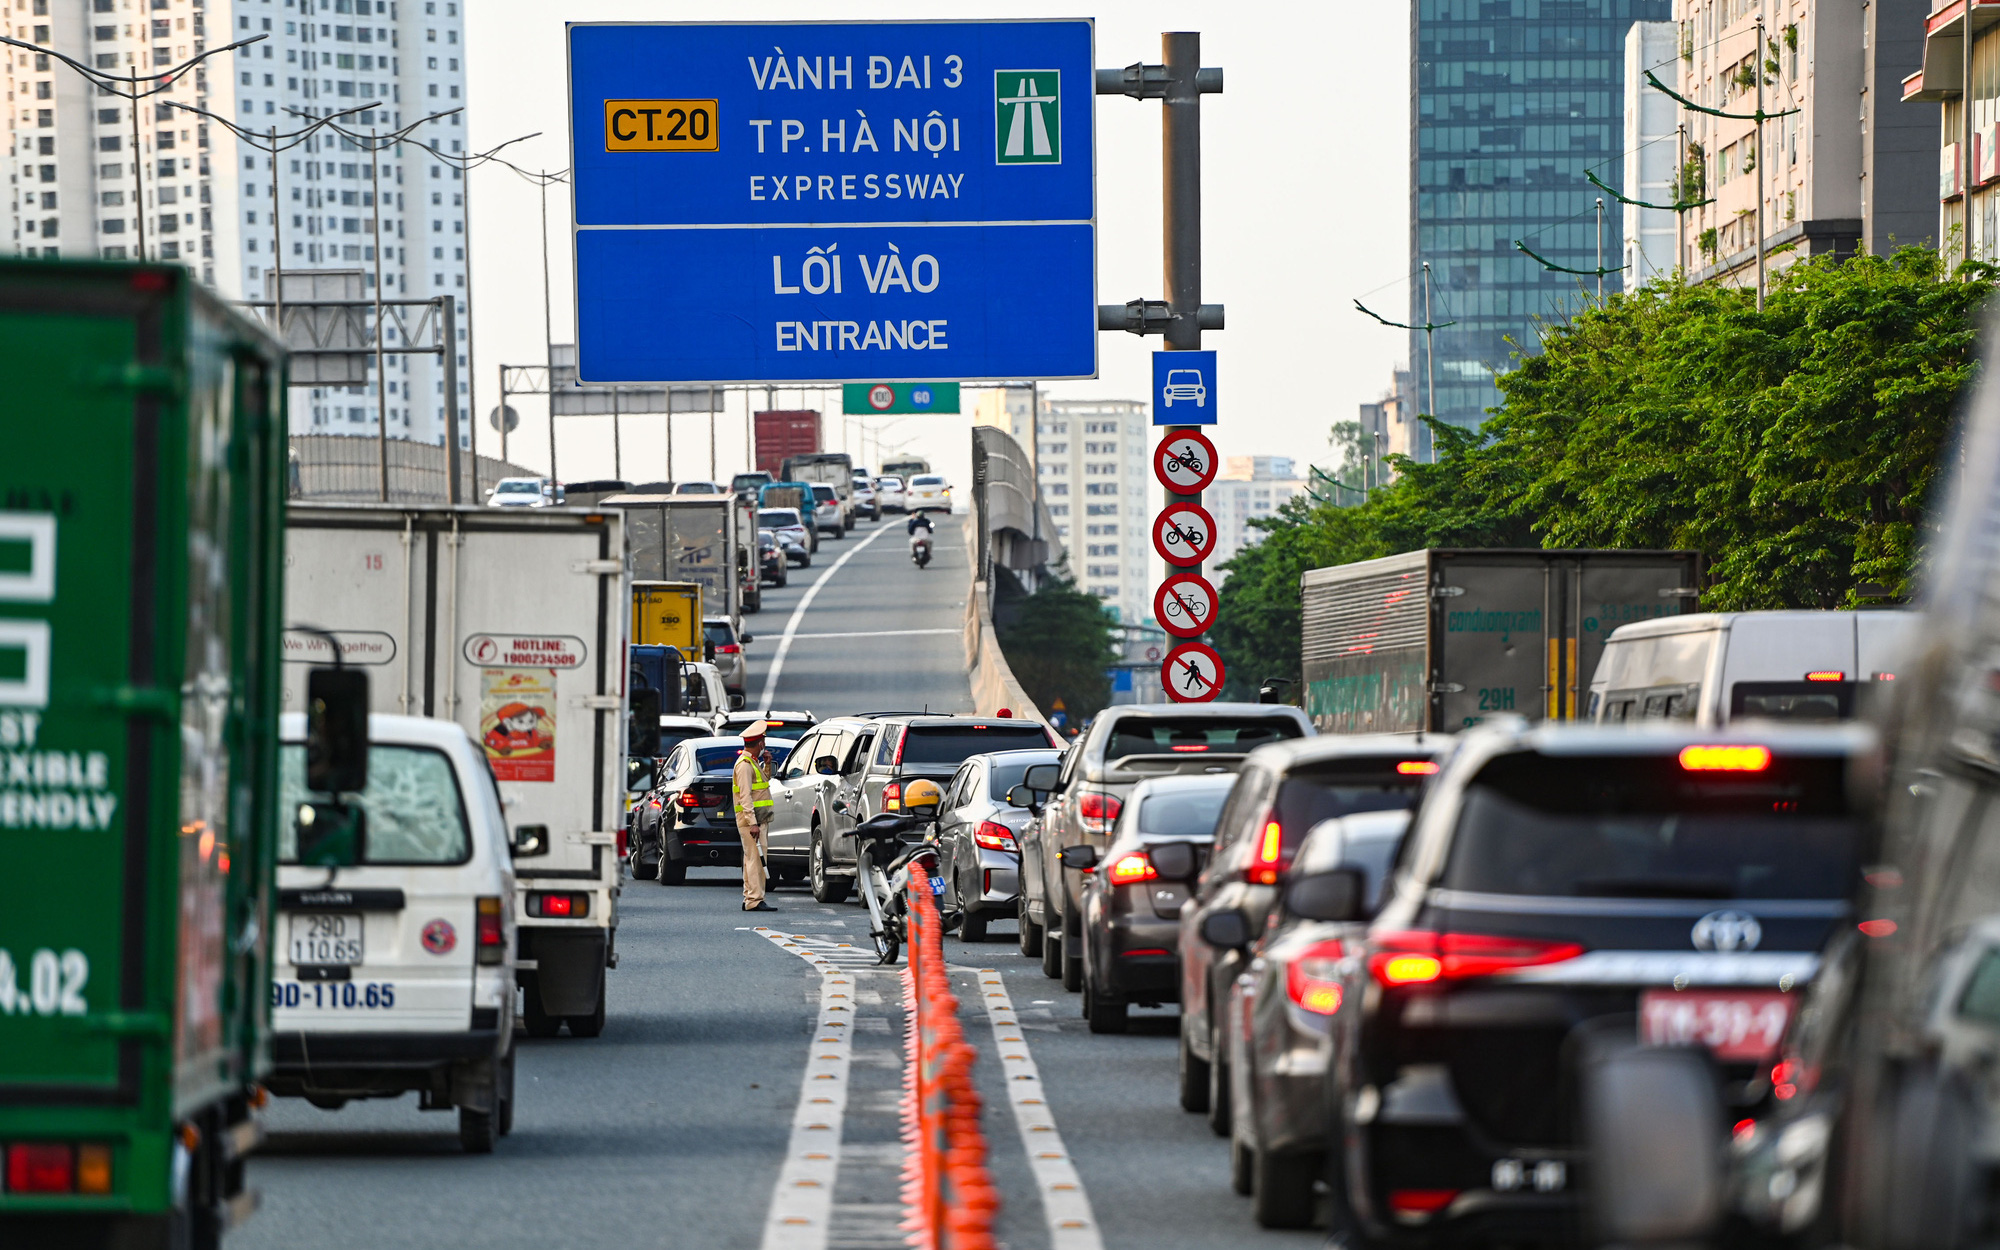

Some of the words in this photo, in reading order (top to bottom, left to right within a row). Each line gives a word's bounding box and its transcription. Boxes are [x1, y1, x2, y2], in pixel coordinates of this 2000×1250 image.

[748, 46, 852, 90] VÀNH
[866, 55, 931, 89] ĐAI
[943, 54, 963, 88] 3
[612, 108, 709, 141] CT.20
[893, 110, 960, 159] NỘI
[750, 173, 964, 201] EXPRESSWAY
[773, 242, 842, 295] LỐI
[858, 241, 940, 294] VÀO
[775, 319, 949, 352] ENTRANCE
[912, 390, 931, 404] 60
[365, 554, 383, 571] 15
[661, 616, 680, 624] ISO
[513, 639, 566, 652] HOTLINE:
[1478, 686, 1515, 711] 29H
[307, 915, 347, 938] 29D
